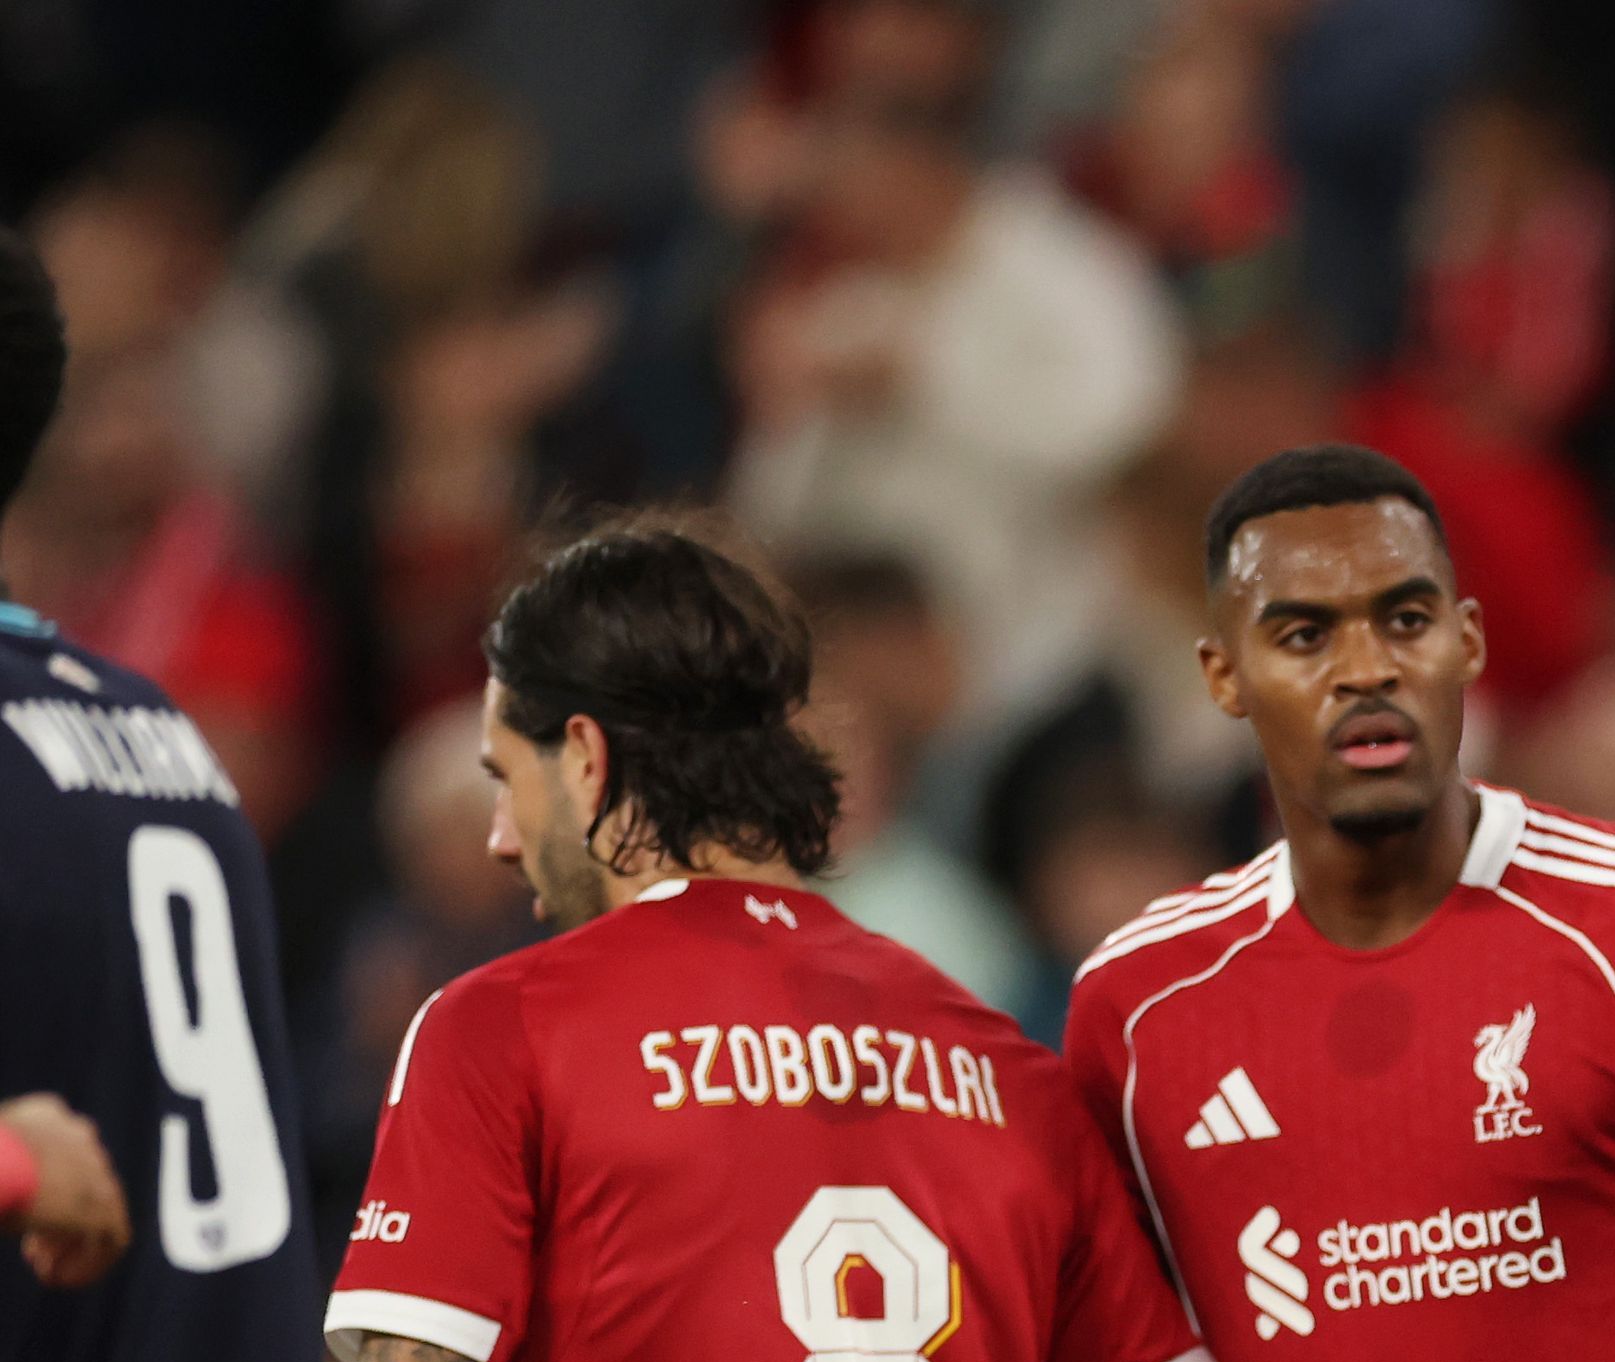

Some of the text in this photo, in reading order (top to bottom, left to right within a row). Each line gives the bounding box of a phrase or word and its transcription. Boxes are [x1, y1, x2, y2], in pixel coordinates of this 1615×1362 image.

[127, 824, 291, 1273] 9
[639, 1023, 1007, 1129] SZOBOSZLAI
[1317, 1196, 1545, 1267] standard
[1323, 1236, 1567, 1311] chartered
